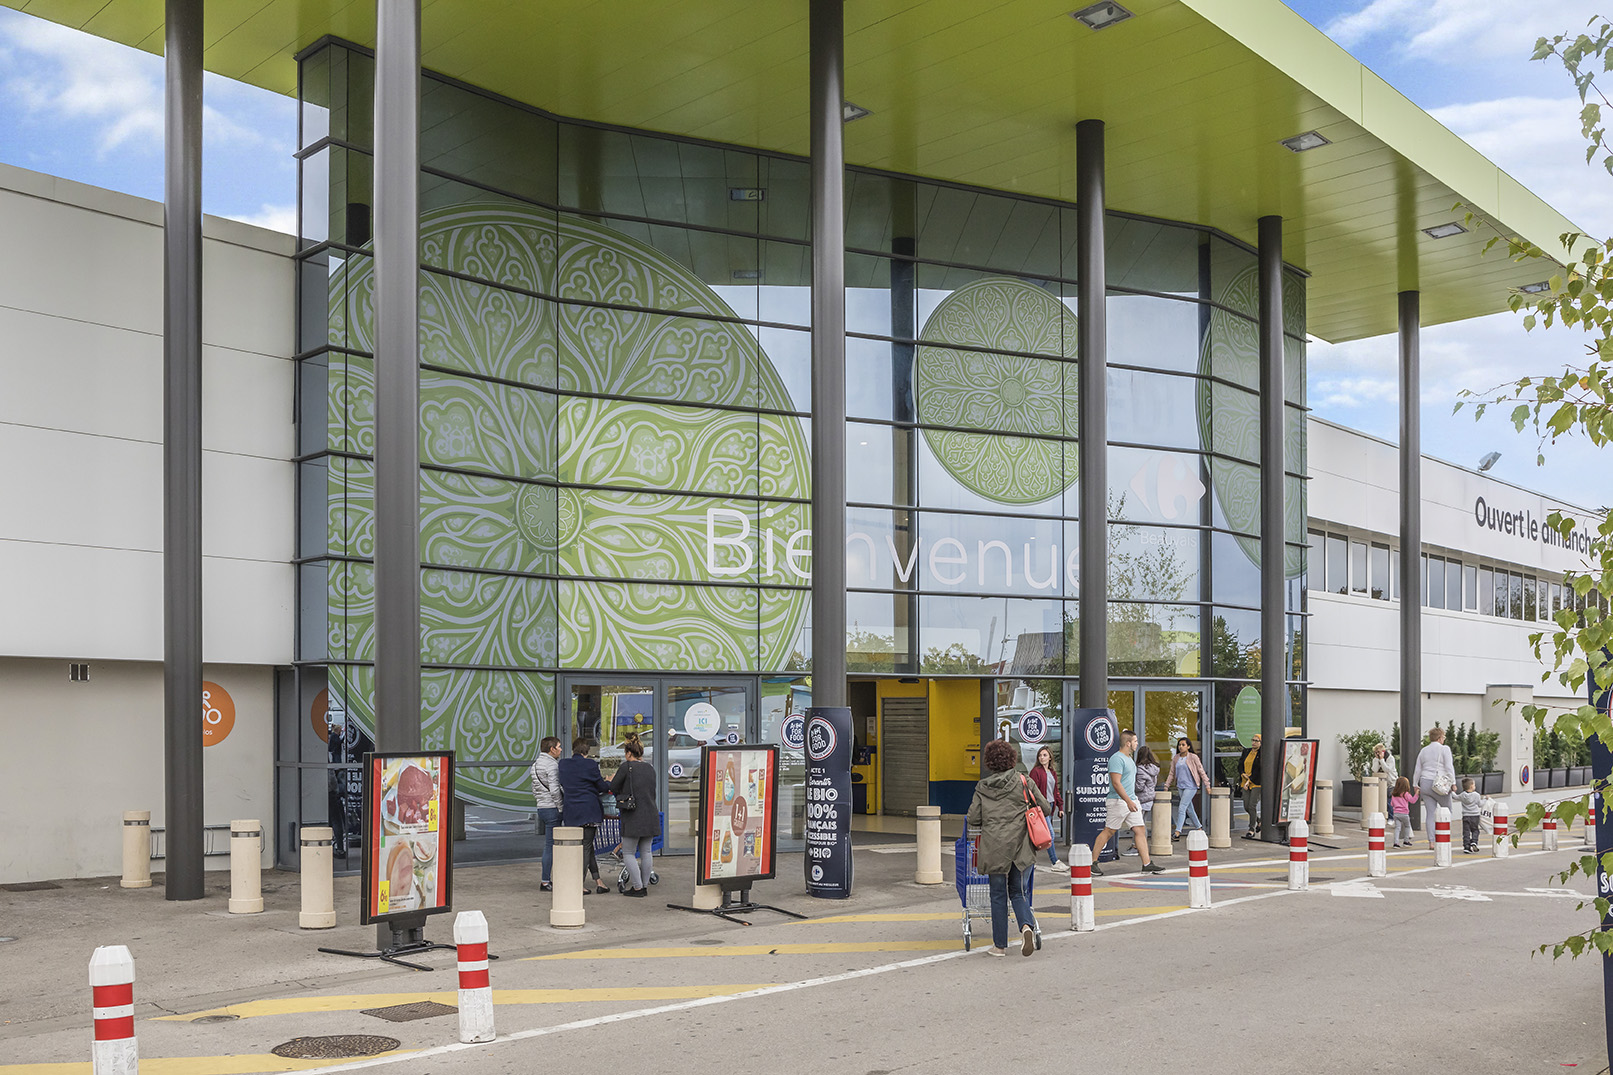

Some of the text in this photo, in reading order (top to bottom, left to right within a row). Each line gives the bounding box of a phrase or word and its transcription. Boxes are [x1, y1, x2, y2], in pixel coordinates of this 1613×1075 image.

[1475, 496, 1525, 538] Ouvert
[1527, 509, 1538, 541] le
[1140, 531, 1197, 548] Beauvais
[811, 740, 827, 751] FOOD
[1092, 764, 1108, 772] Bann
[813, 788, 838, 801] BIO
[1076, 787, 1110, 795] SUBSTAN
